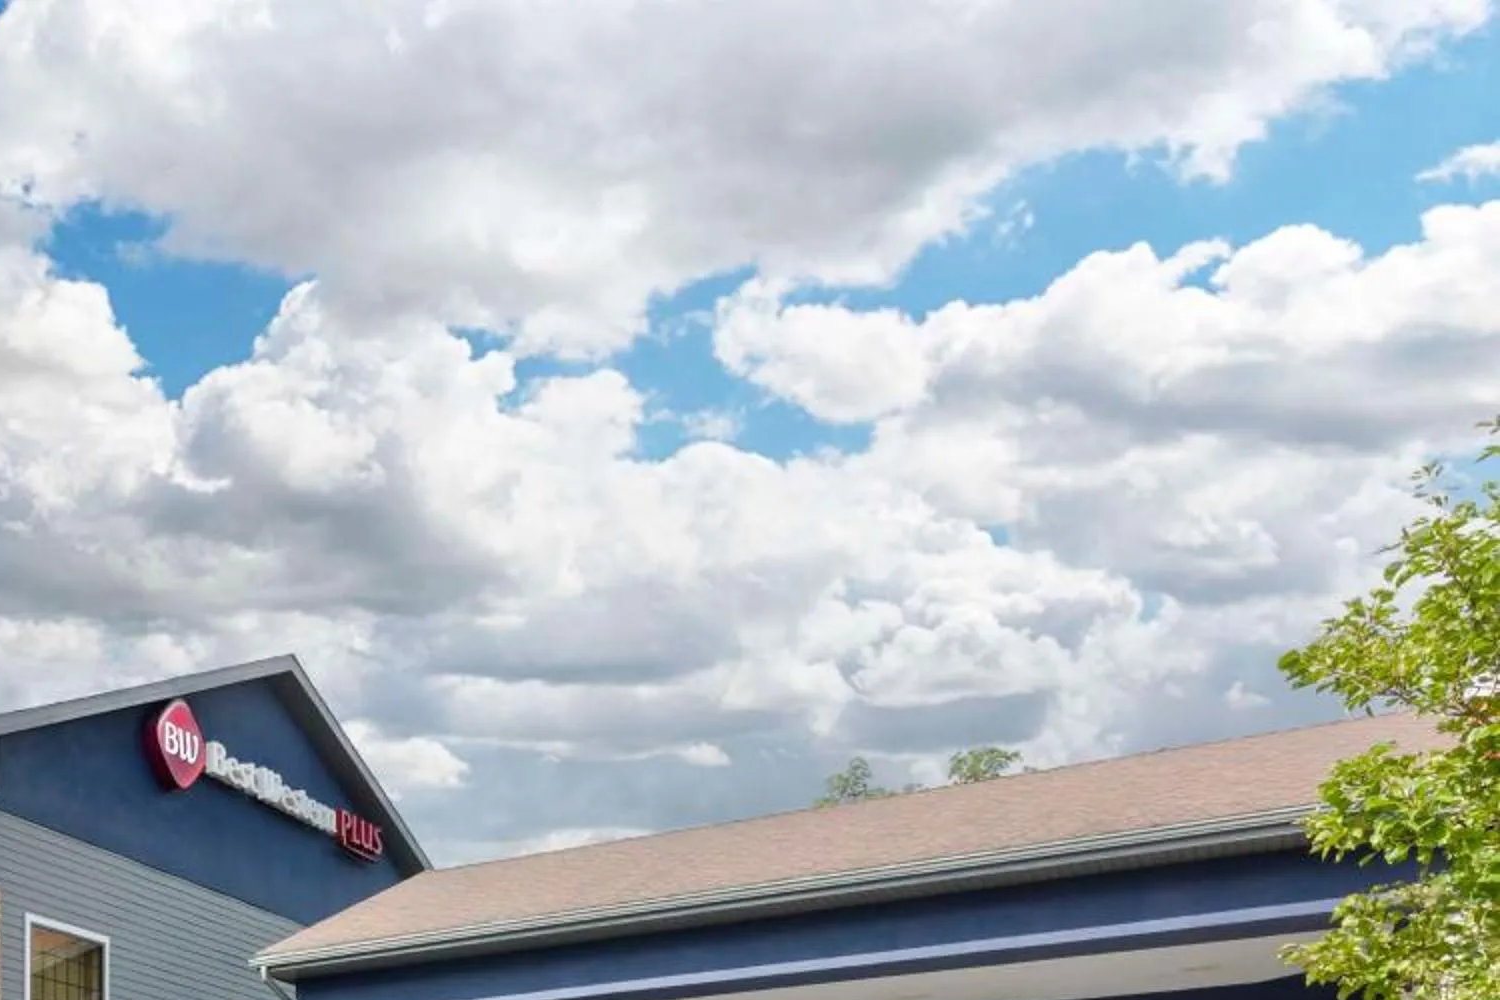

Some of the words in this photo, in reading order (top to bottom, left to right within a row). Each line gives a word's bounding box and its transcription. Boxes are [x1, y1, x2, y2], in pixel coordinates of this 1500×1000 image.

[164, 721, 199, 764] BW
[206, 741, 254, 794] Best
[338, 807, 383, 855] PLUS
